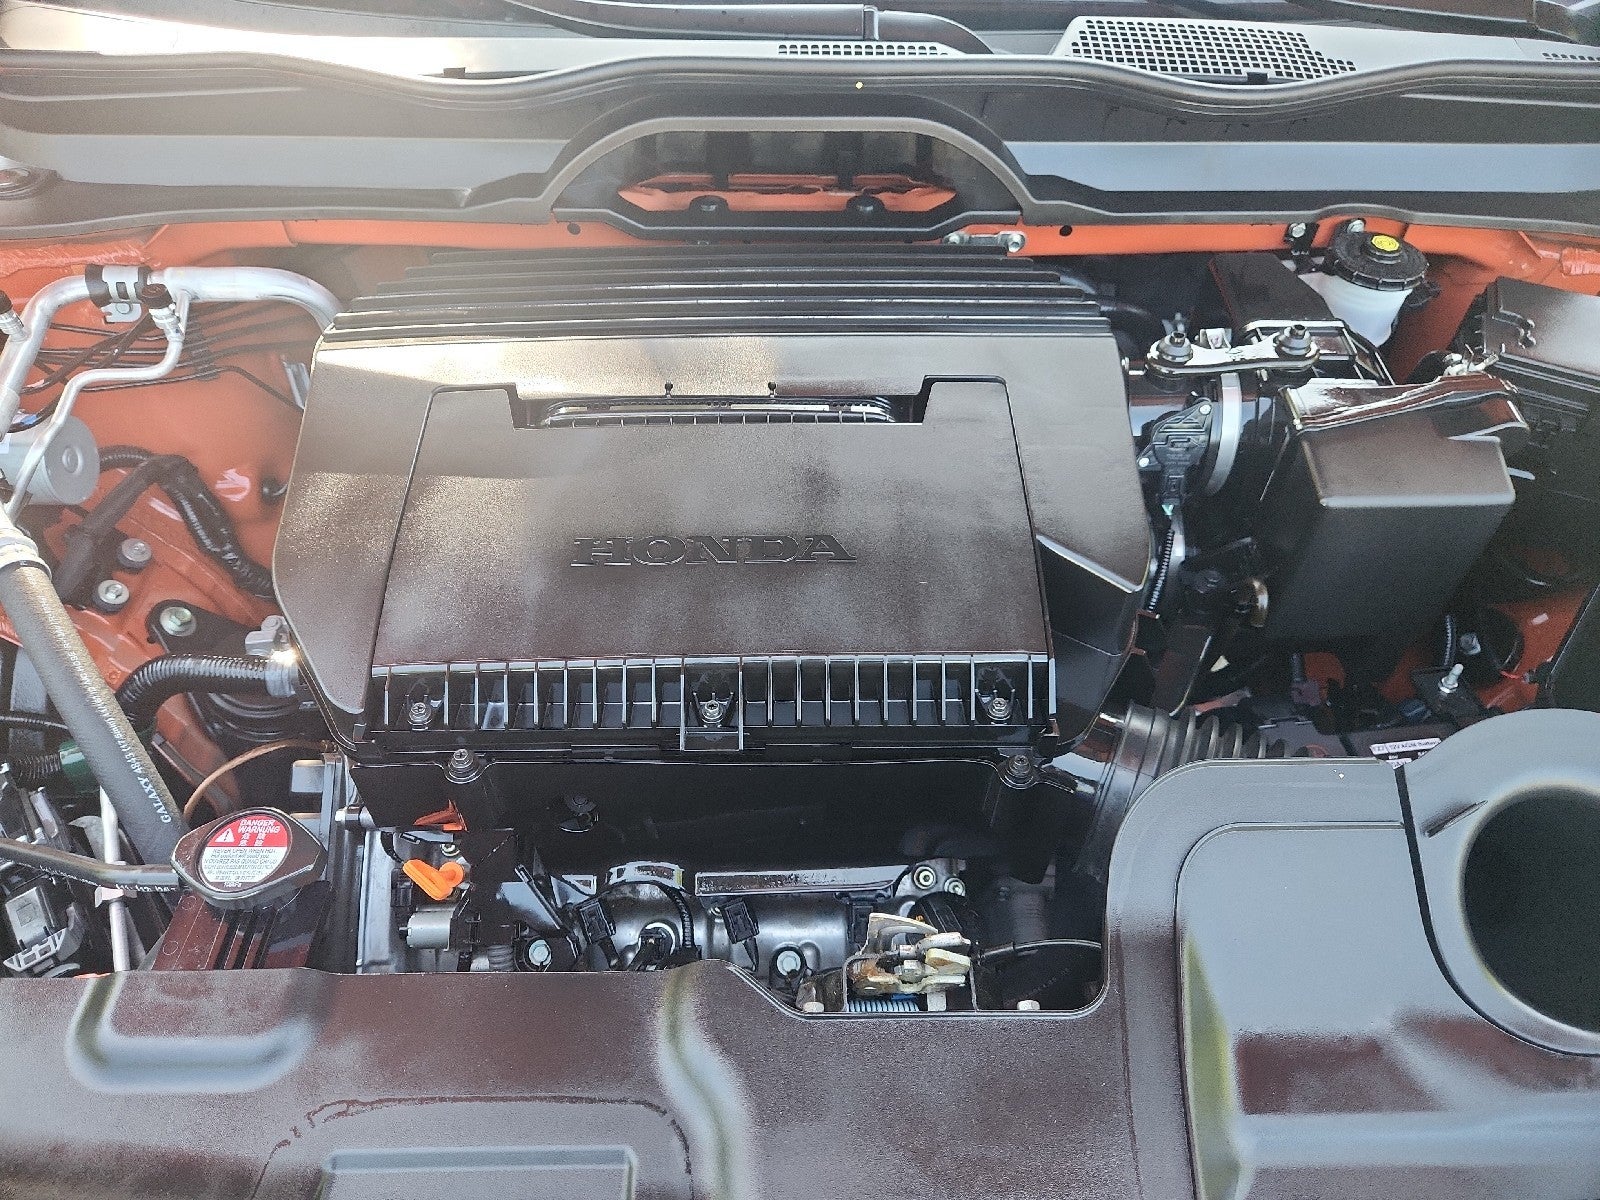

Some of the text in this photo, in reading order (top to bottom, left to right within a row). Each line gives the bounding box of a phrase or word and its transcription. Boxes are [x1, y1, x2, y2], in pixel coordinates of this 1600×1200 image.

[570, 535, 857, 567] HONDA
[68, 650, 83, 672] HOSE
[138, 777, 171, 823] GALAXY
[237, 825, 280, 834] WARNING
[239, 819, 276, 827] DANGER
